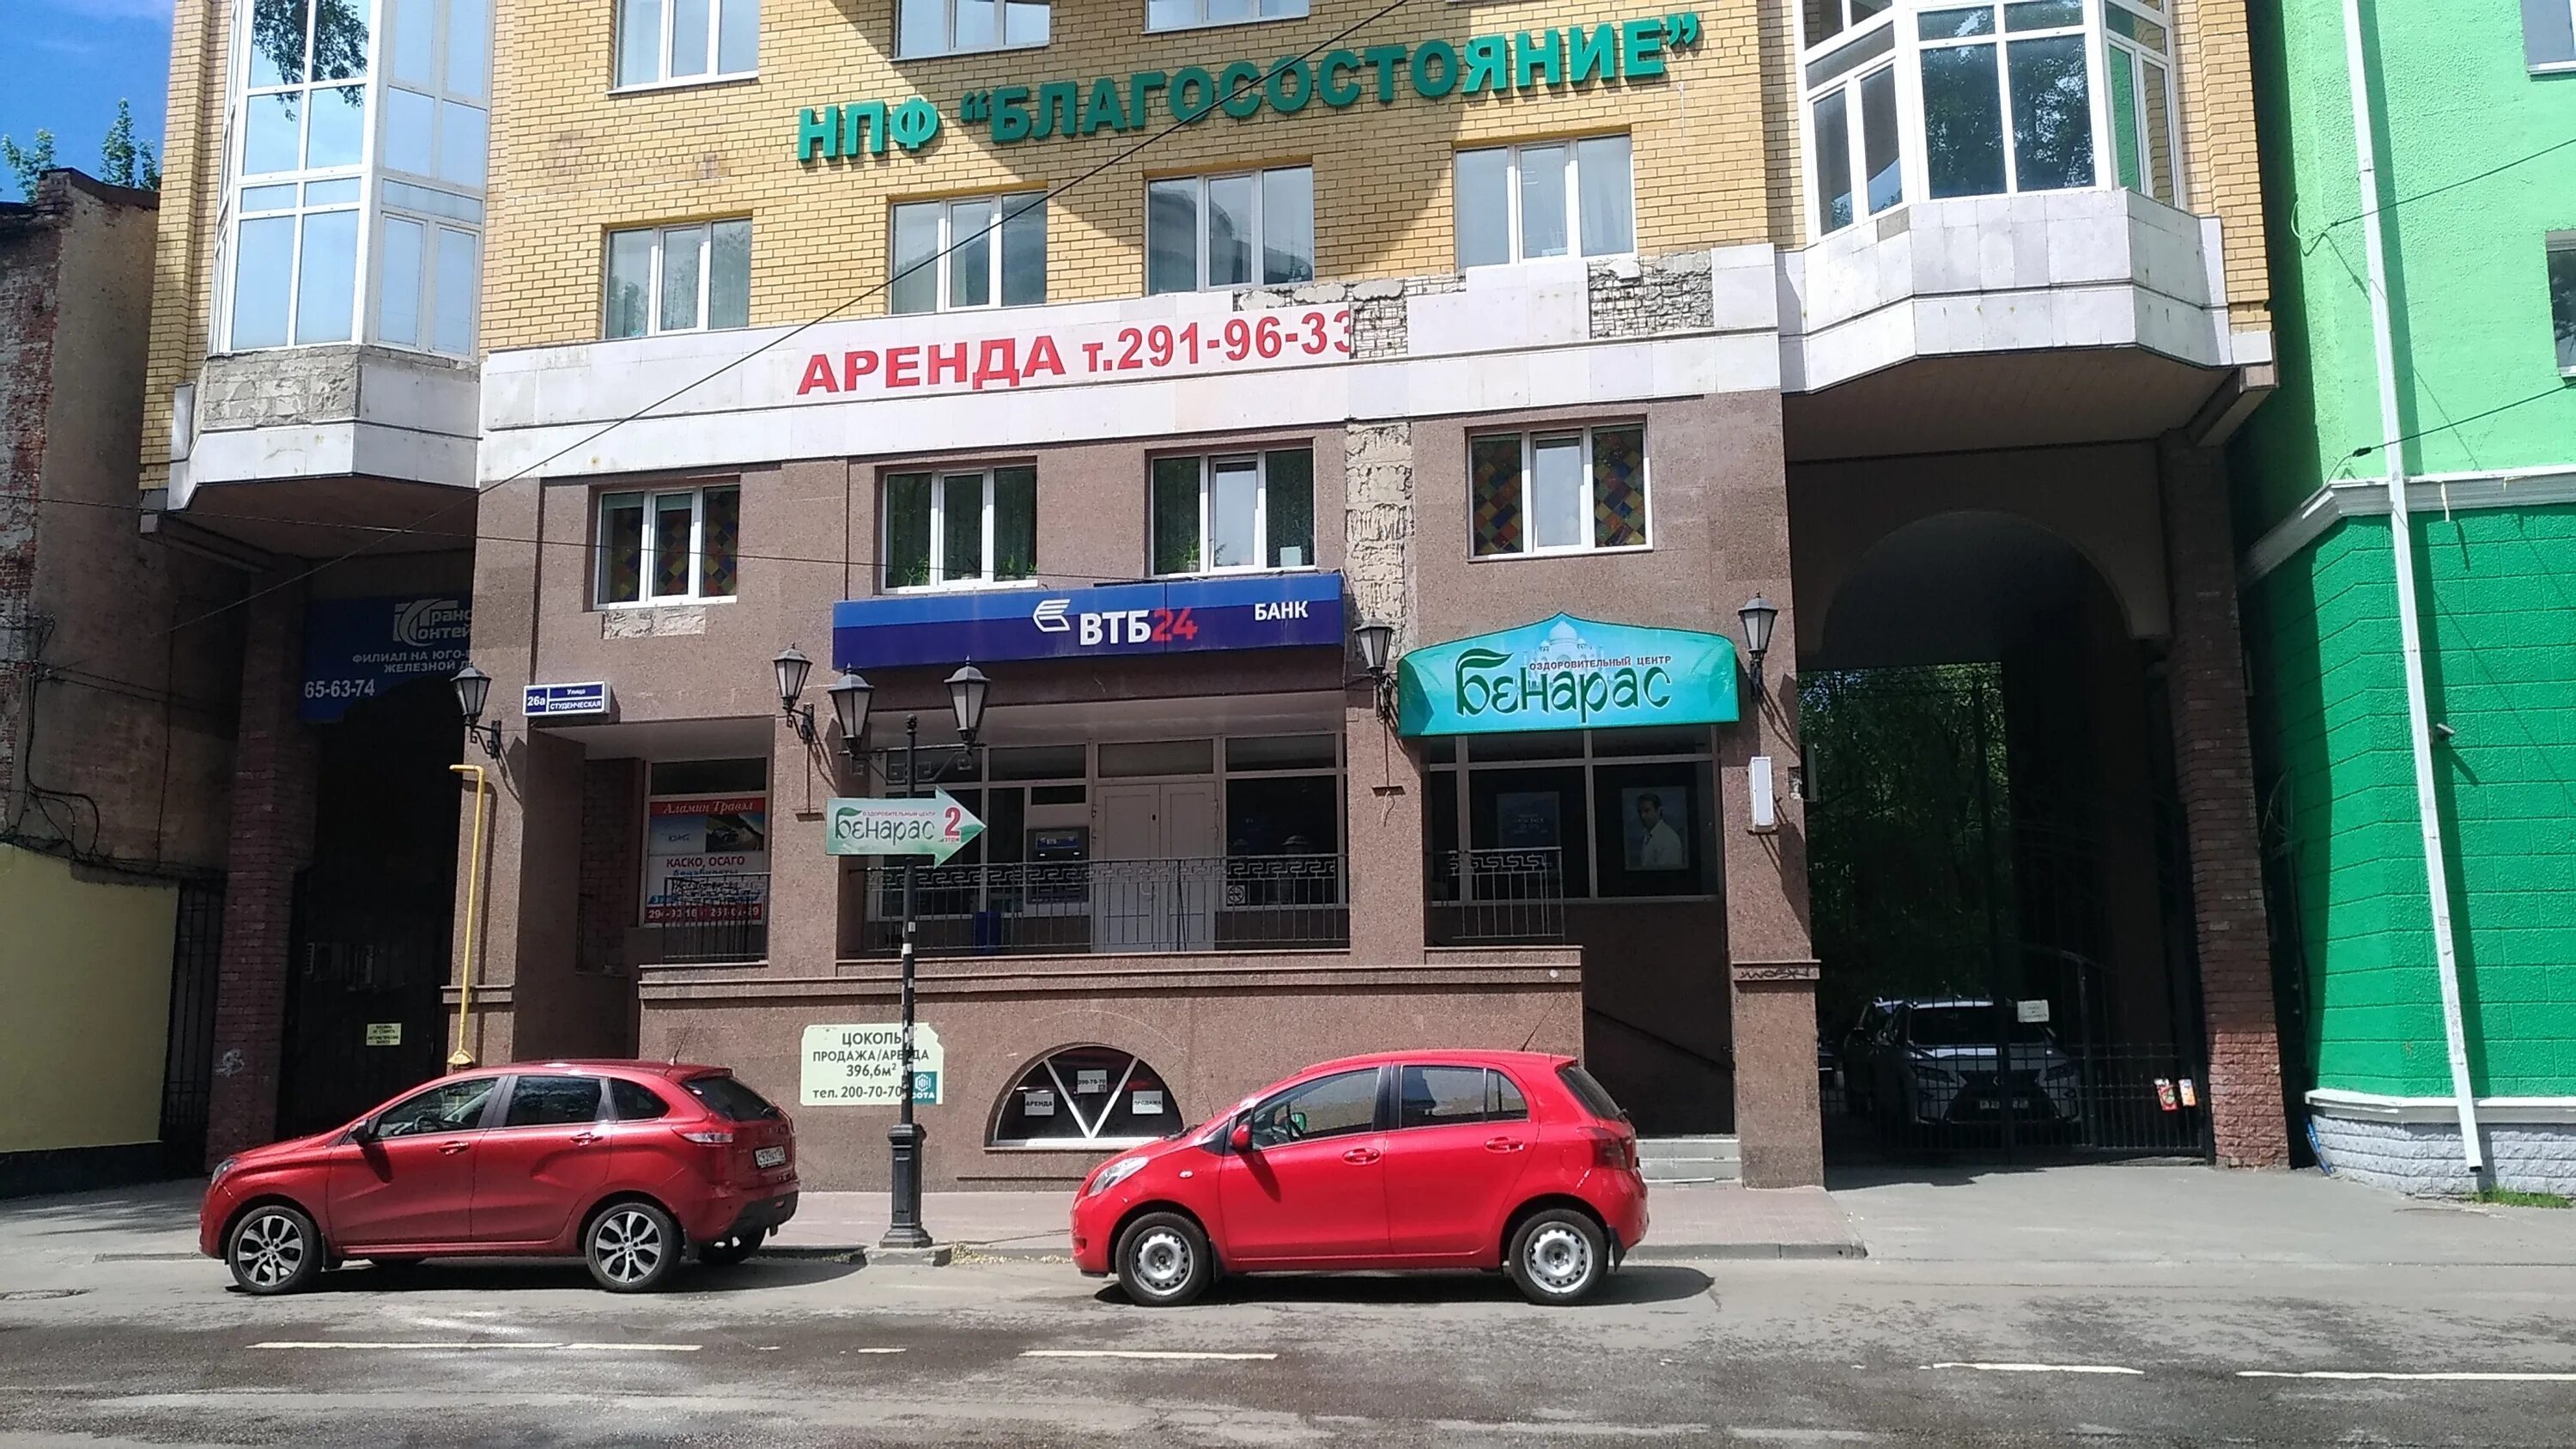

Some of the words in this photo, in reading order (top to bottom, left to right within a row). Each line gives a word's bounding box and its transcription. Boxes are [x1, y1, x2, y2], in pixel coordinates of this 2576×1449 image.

[797, 95, 939, 161] НПФ
[796, 335, 1066, 396] АРЕНДА
[1079, 607, 1199, 646] ВТБ24
[1255, 600, 1309, 621] БАНК
[352, 652, 407, 664] ФИЛИАЛ
[410, 651, 428, 661] НА
[1529, 656, 1631, 671] ОЗДОРОВИТЕЛЬНЫЙ
[1637, 655, 1672, 667] ЦЕНТР
[384, 660, 456, 673] ЖЕЛЕЗНОЙ
[305, 679, 375, 698] 65-63-74
[550, 700, 601, 710] СТУДЕНЧЕСКАЯ
[945, 807, 961, 837] 2
[666, 857, 705, 868] КАСКО,
[708, 855, 745, 866] ОСАГО
[841, 1032, 902, 1047] ЦОКОЛЬ
[812, 1048, 929, 1063] ПРОДАЖА/АРЕДА
[812, 1087, 838, 1099] тел.
[841, 1085, 902, 1099] 200-70-70
